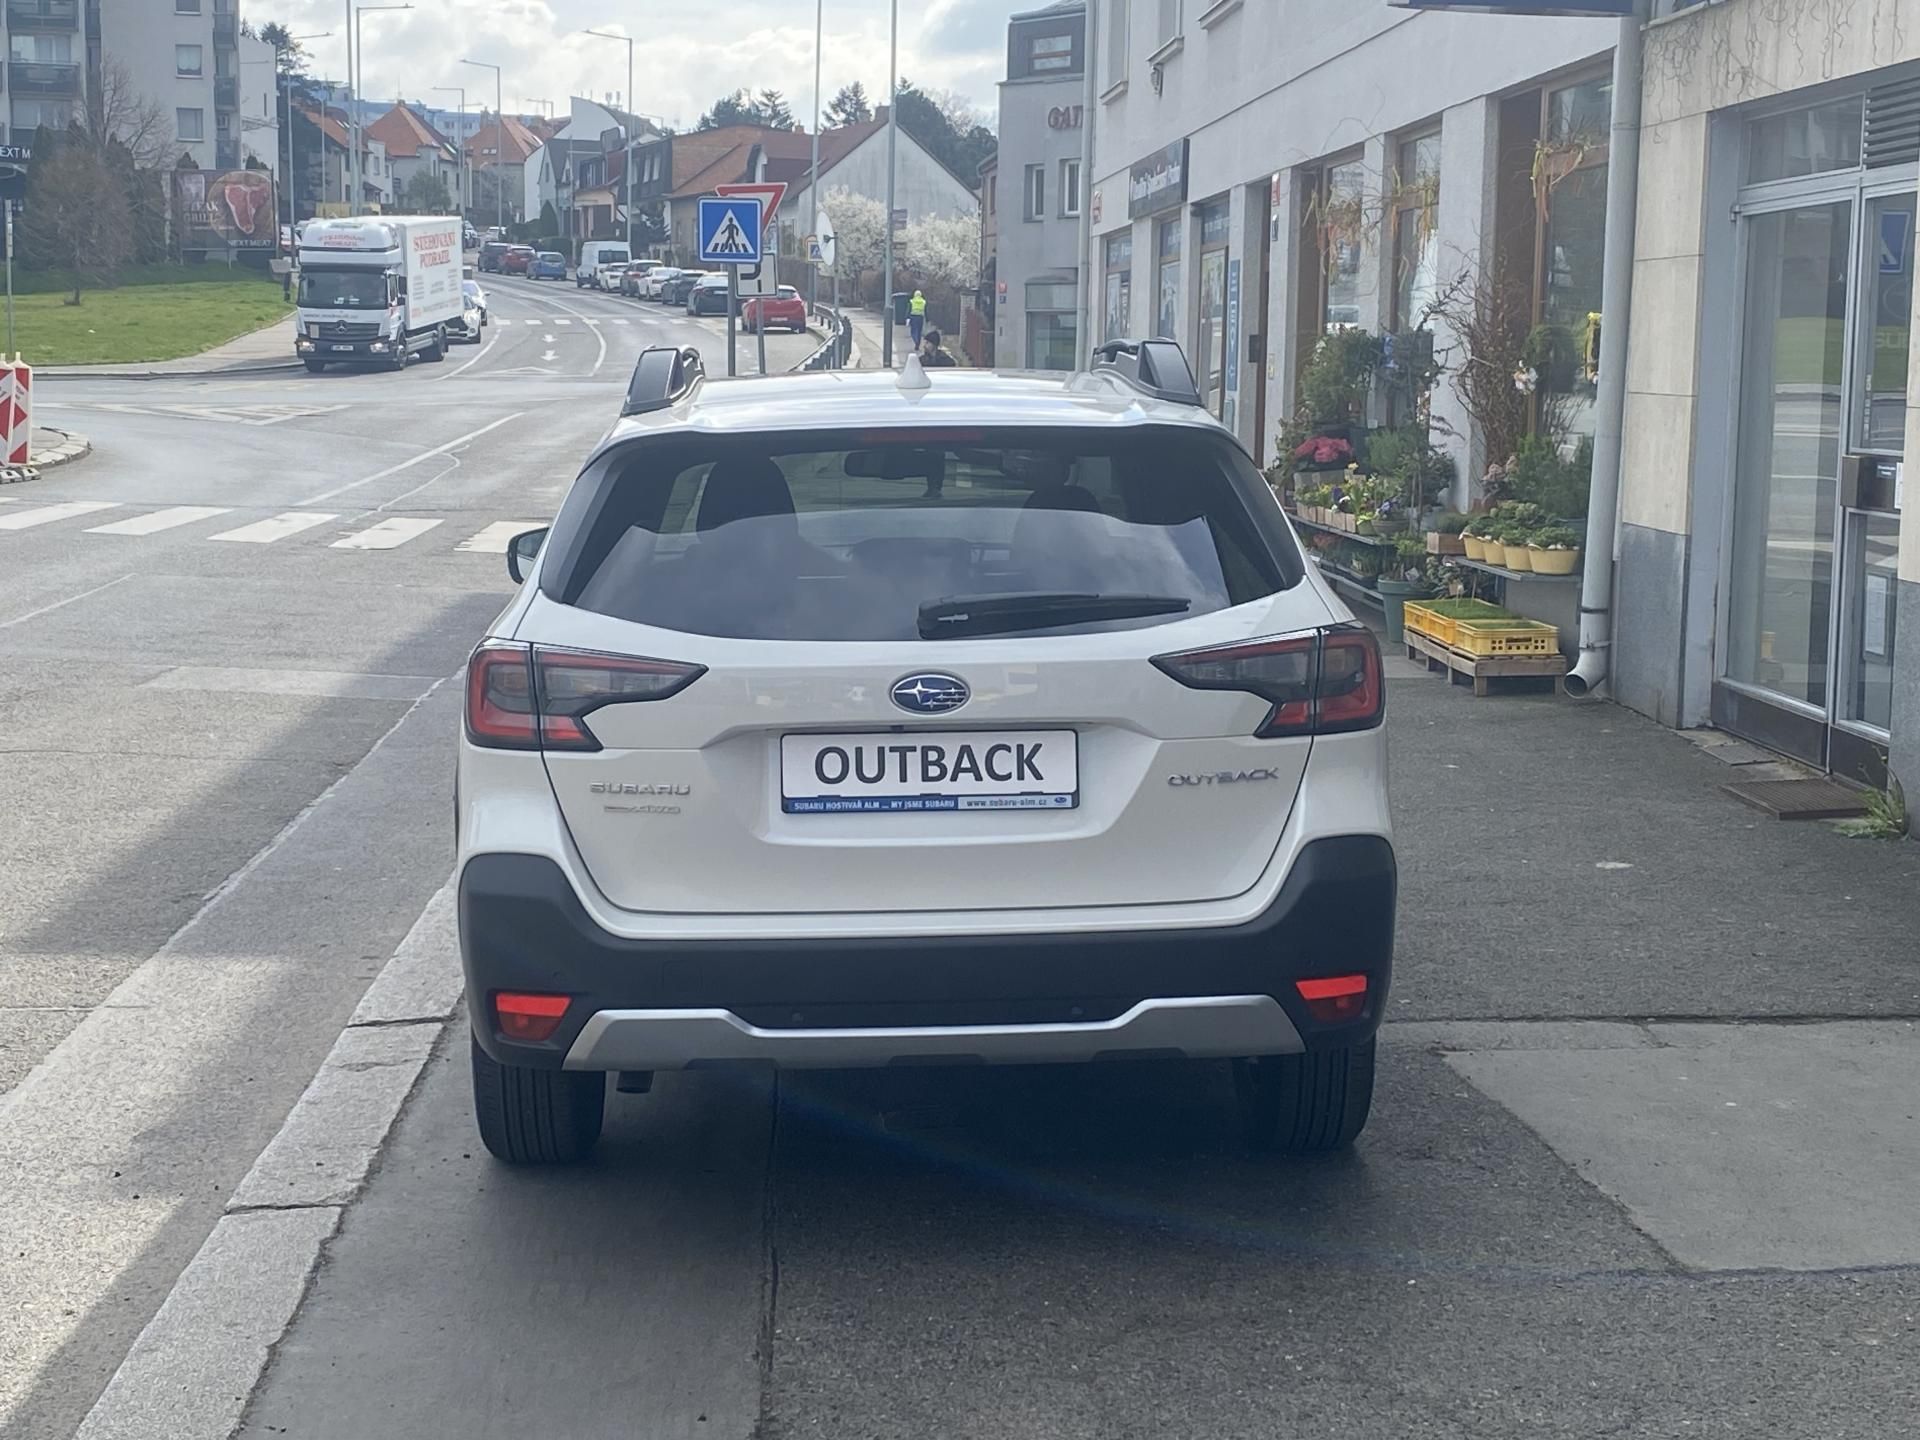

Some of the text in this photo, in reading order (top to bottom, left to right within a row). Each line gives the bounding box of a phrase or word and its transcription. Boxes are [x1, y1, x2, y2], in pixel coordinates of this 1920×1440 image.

[815, 743, 1044, 785] OUTBACK
[1168, 768, 1278, 786] OUTBACK
[590, 782, 691, 796] SUBARU
[794, 800, 823, 810] SUBARU
[826, 799, 862, 809] HOSTIVAŘ
[864, 800, 880, 809] ALM
[891, 800, 902, 809] MY
[904, 800, 923, 809] JSME
[925, 800, 955, 808] SUBARU
[966, 798, 1047, 807] www.subaru-alm.cz
